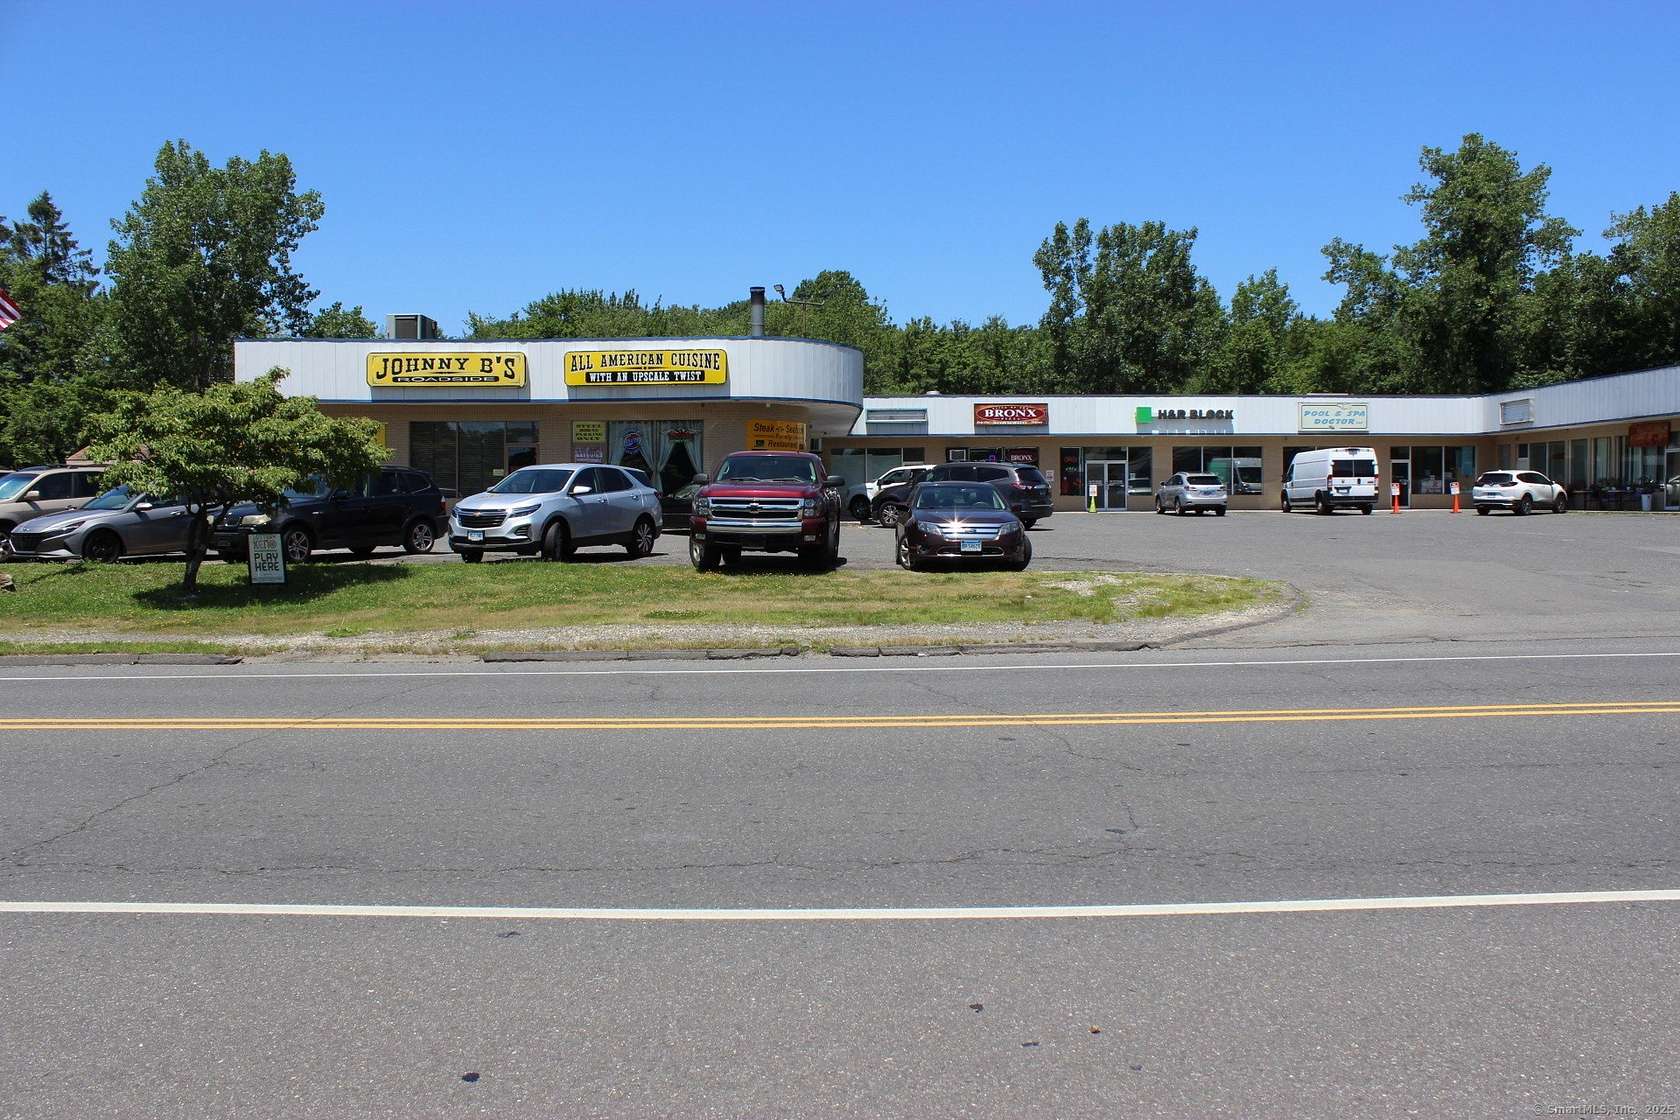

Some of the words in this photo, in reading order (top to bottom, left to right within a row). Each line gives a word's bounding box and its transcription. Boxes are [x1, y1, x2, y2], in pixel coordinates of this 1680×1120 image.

[571, 354, 593, 372] ALL
[600, 353, 664, 368] AMERICAN
[671, 352, 720, 371] CUISINE
[376, 358, 469, 379] JOHNNY
[480, 356, 515, 379] B'S
[589, 373, 611, 383] WITH
[616, 373, 628, 382] AN
[632, 372, 670, 382] UPSCALE
[674, 371, 702, 382] TWIST
[985, 409, 1037, 417] BRONX
[1158, 409, 1187, 419] H&R
[1190, 409, 1234, 419] BLOCK
[254, 553, 278, 561] PLAY
[255, 562, 279, 571] HERE
